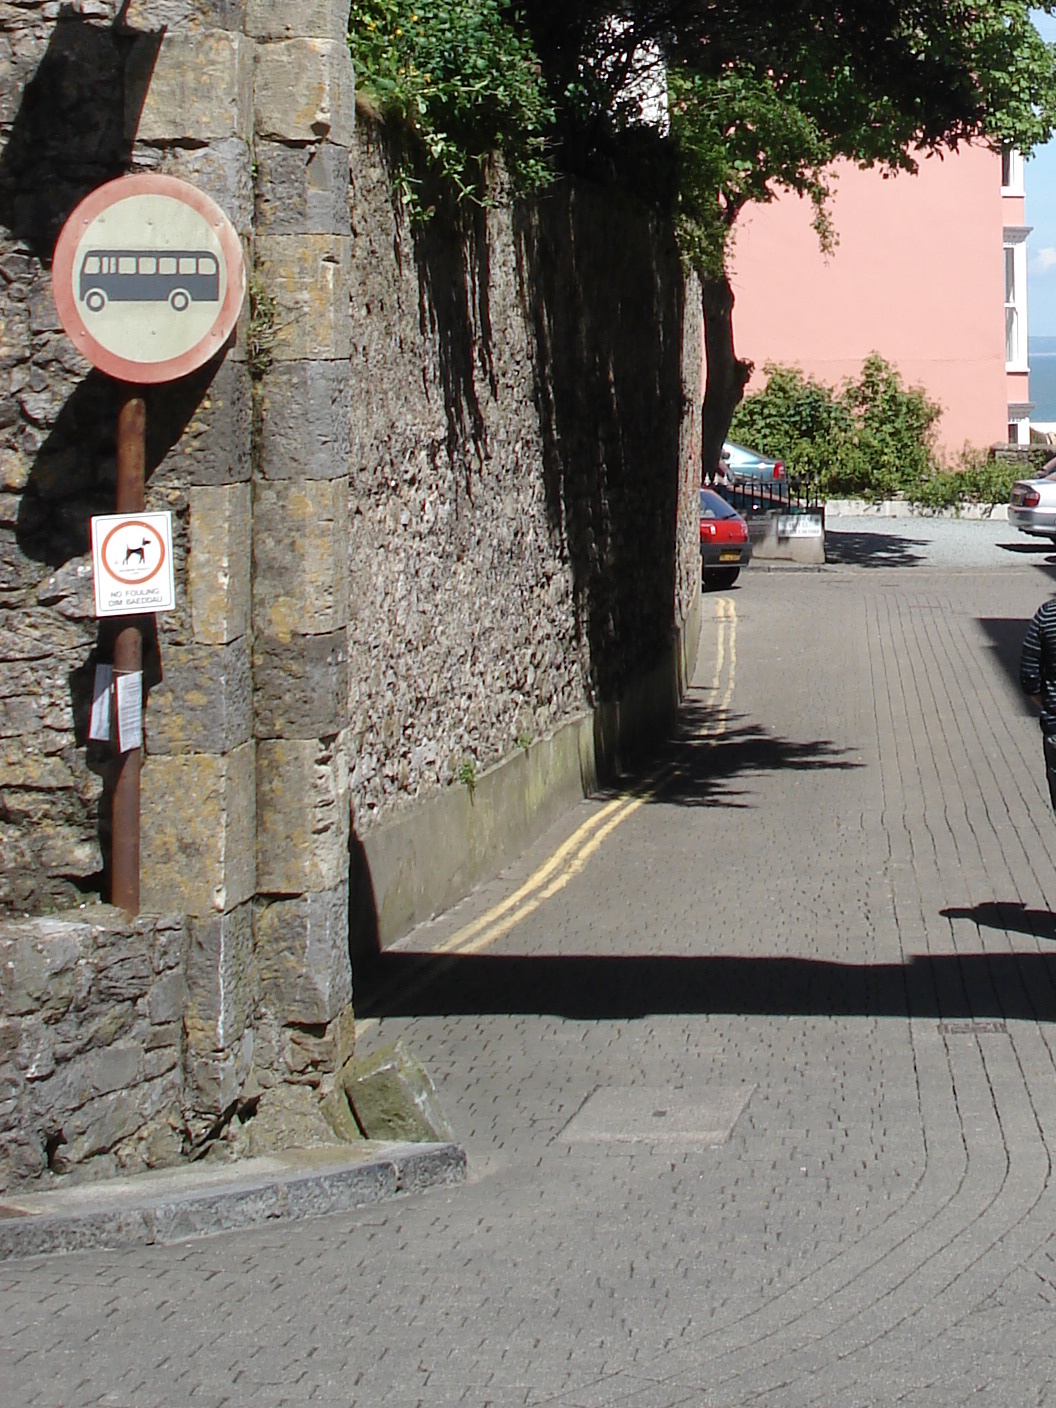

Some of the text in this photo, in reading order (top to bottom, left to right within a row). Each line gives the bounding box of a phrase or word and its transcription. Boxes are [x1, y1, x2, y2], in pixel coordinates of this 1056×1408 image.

[110, 588, 160, 598] NO FOULING
[126, 596, 163, 606] BAEDDAU
